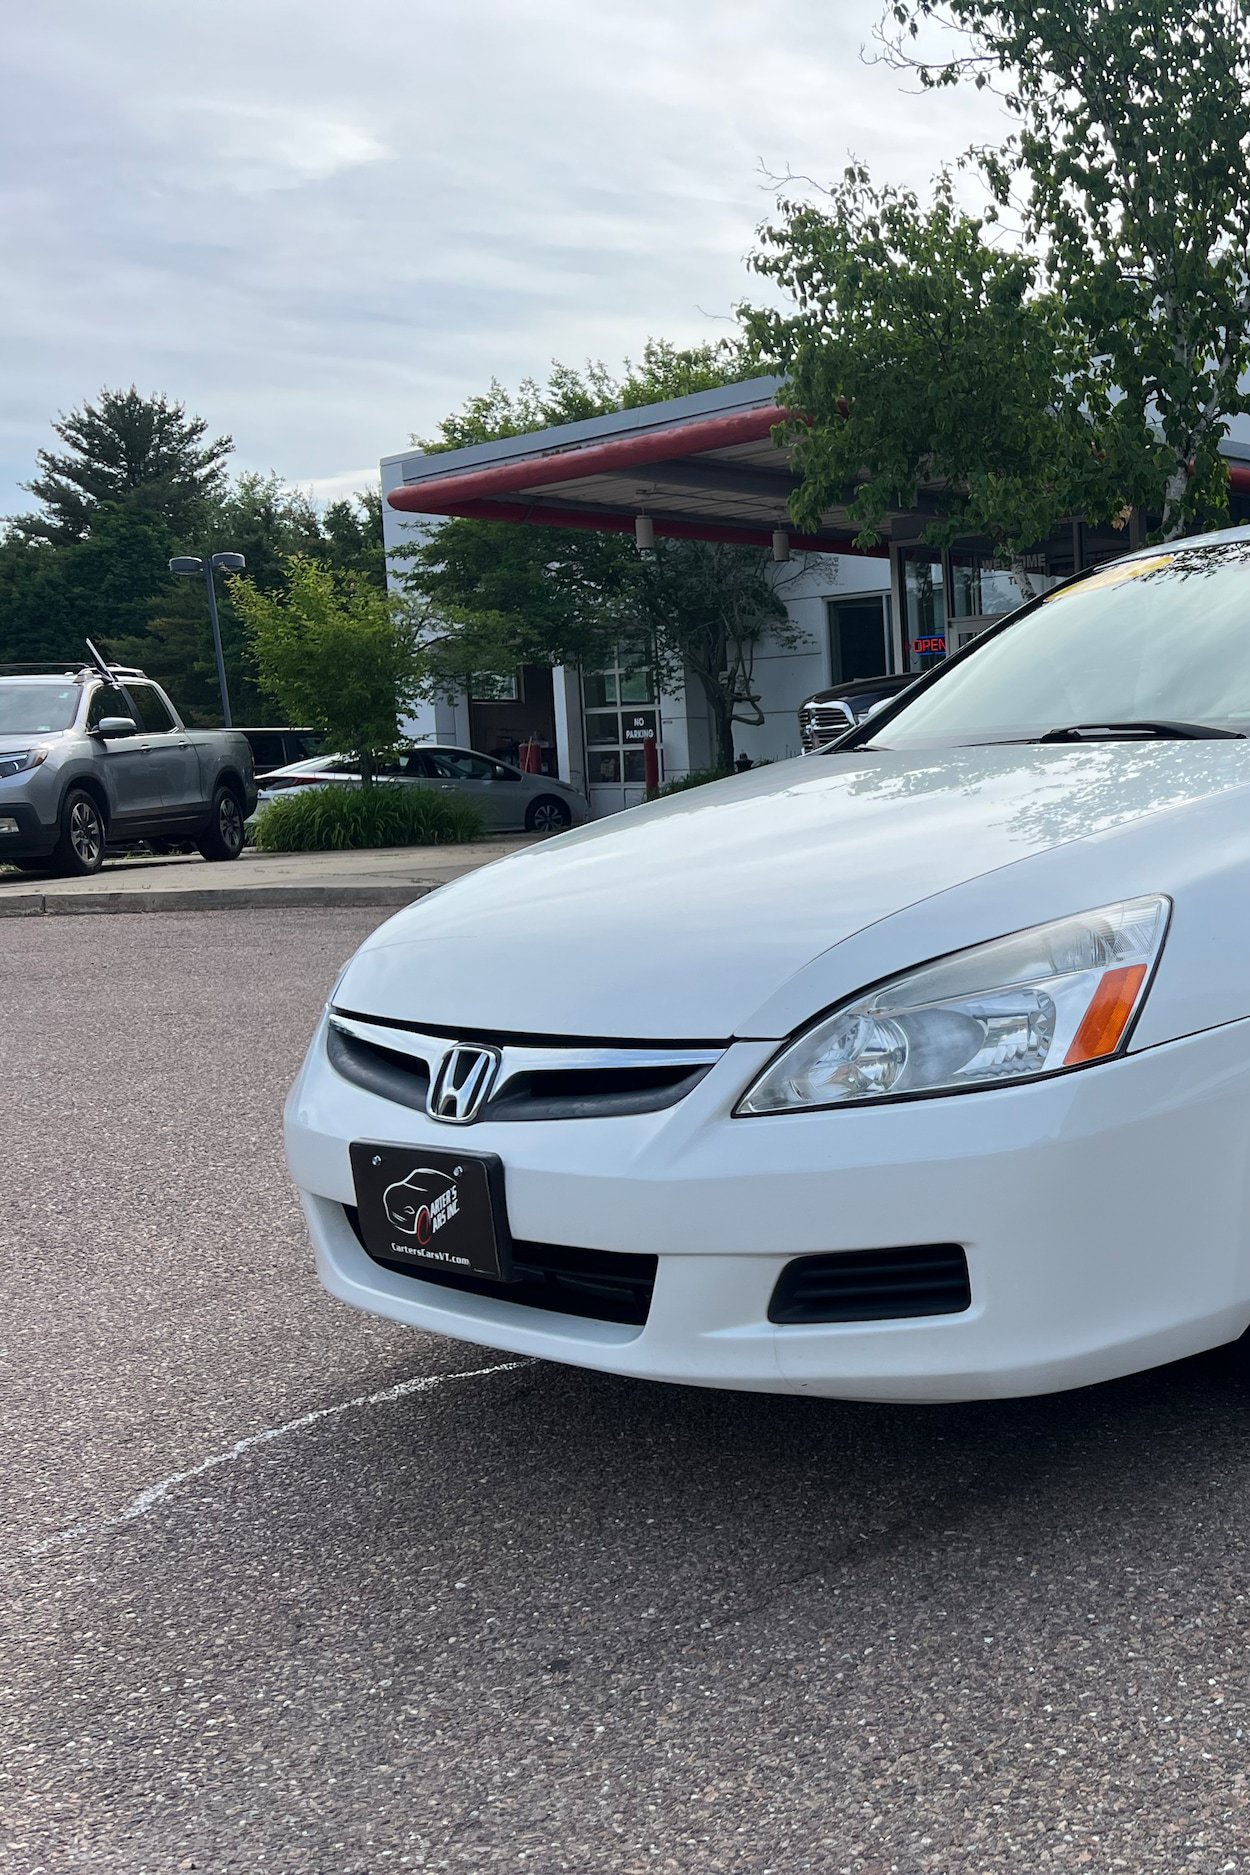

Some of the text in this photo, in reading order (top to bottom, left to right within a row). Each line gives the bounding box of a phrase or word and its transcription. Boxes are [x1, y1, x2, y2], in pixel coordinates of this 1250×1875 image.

[982, 553, 1046, 574] WELOME
[913, 638, 946, 653] OPEN
[633, 717, 645, 727] NO
[625, 729, 654, 739] PARKING
[390, 1242, 470, 1266] CartersCarsVT.com
